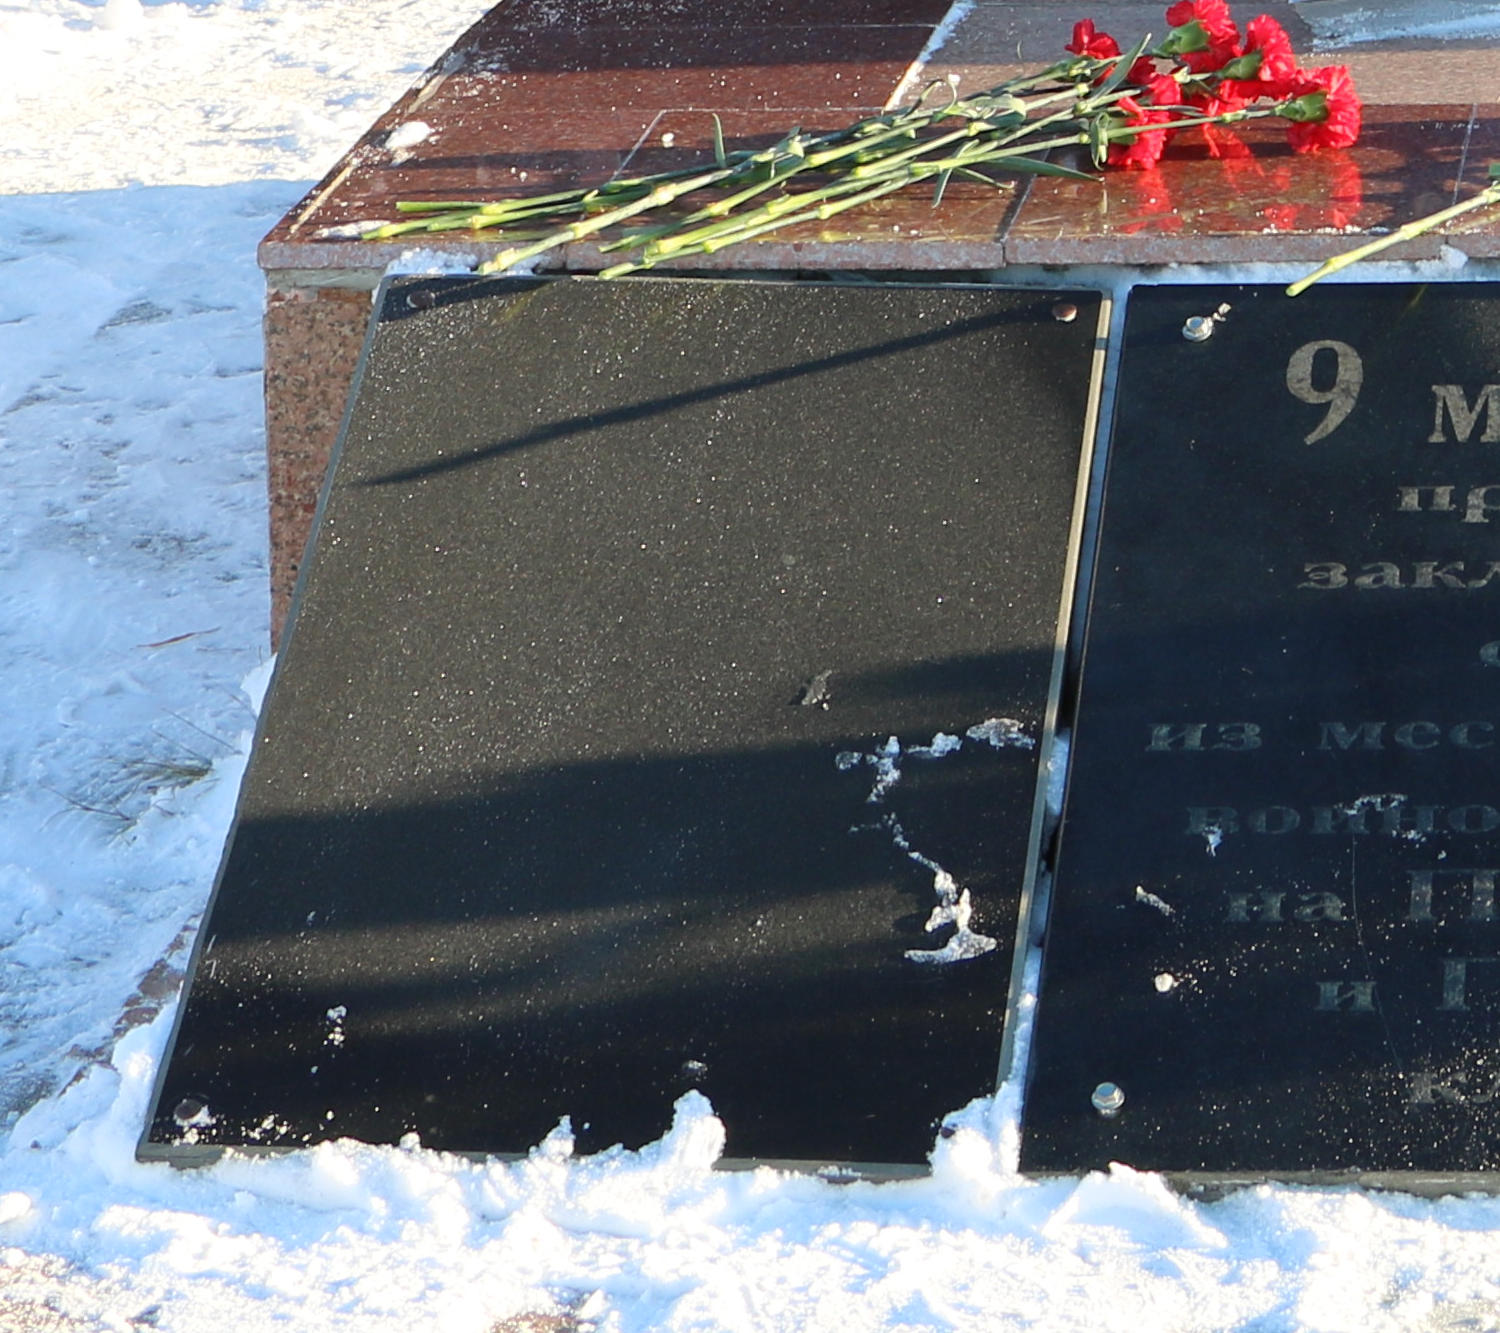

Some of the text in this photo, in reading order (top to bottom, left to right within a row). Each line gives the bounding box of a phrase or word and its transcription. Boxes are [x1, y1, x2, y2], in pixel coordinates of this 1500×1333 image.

[1286, 339, 1364, 447] 9
[1144, 719, 1265, 753] из
[1223, 887, 1348, 925] на
[1313, 980, 1378, 1013] и
